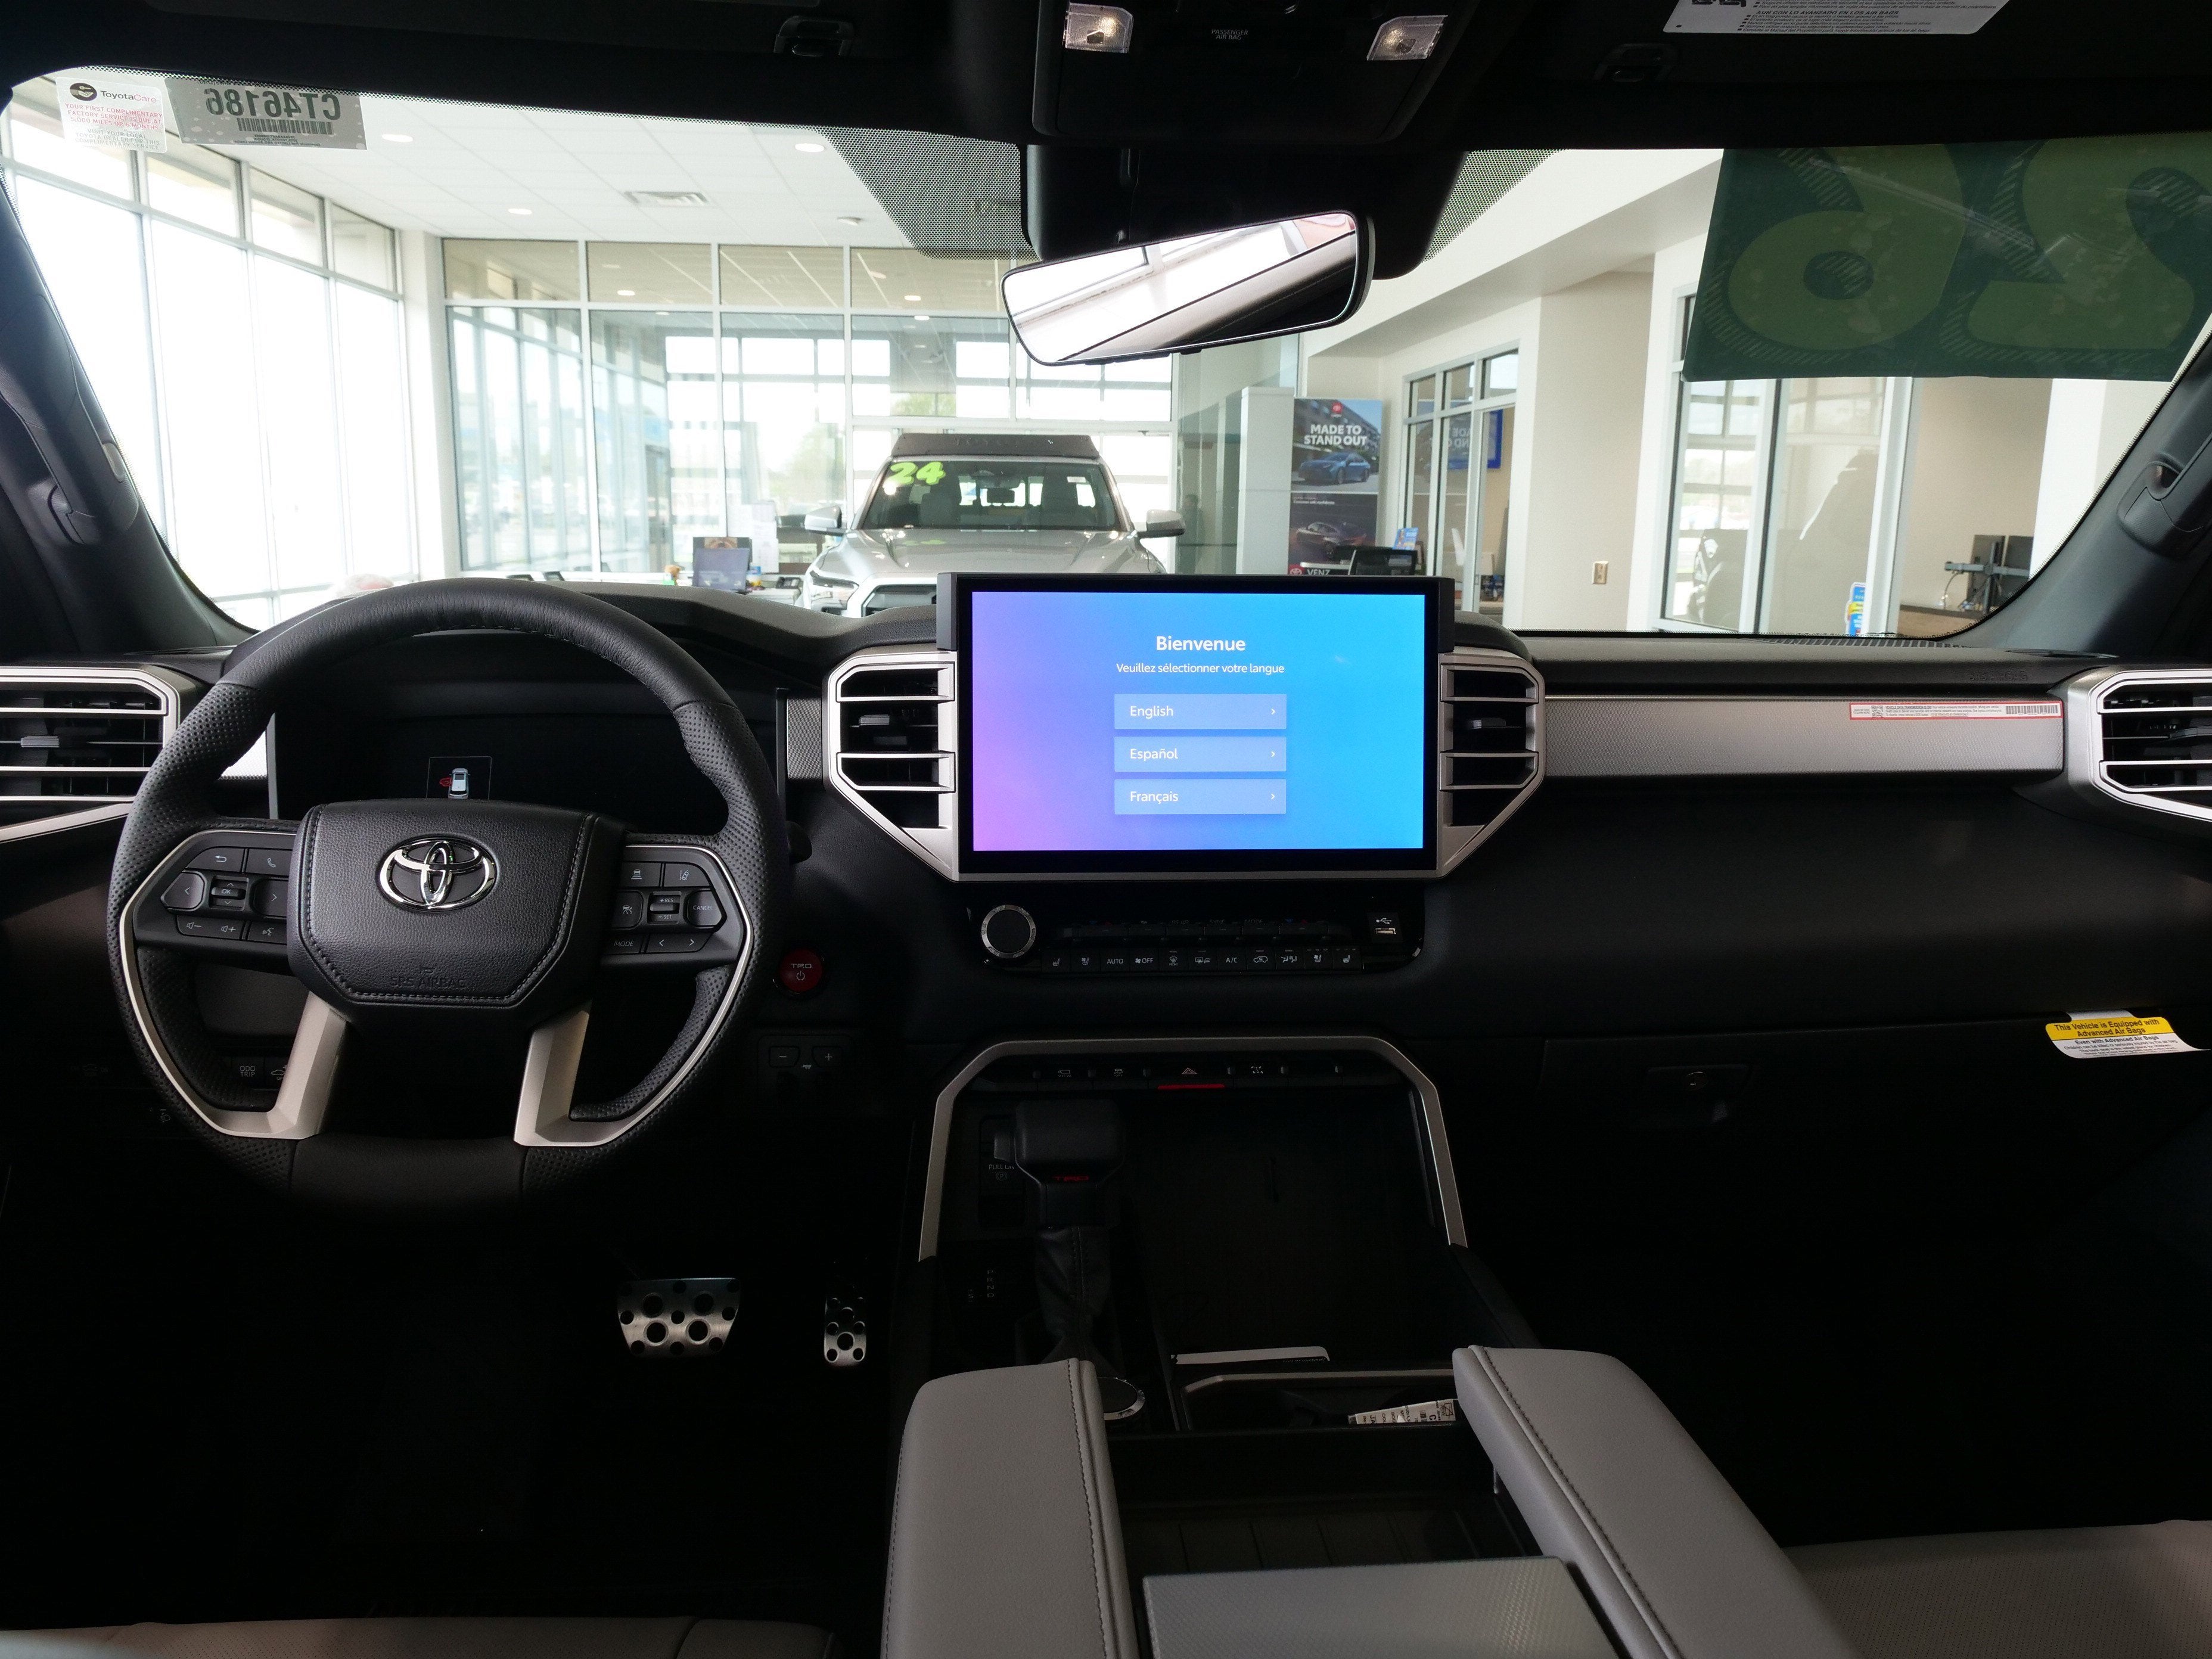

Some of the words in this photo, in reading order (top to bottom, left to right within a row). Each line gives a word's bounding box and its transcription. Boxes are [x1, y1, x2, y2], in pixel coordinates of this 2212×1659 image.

[100, 90, 157, 103] ToyotaCare
[107, 107, 163, 118] COMPLIMENTARY
[1310, 424, 1344, 434] MADE
[1346, 425, 1362, 435] TO
[1304, 434, 1342, 445] STAND
[1343, 435, 1368, 446] OUT
[890, 461, 946, 485] 24
[1156, 636, 1245, 651] Bienvenue
[1116, 663, 1156, 673] Veuillez
[1158, 663, 1220, 673] sélectionner
[1222, 664, 1248, 673] votre
[1250, 663, 1285, 675] langue
[1130, 706, 1174, 719] English
[1130, 748, 1178, 761] Español
[1130, 791, 1179, 804] Français
[2109, 1020, 2142, 1029] Equipped
[2077, 1029, 2113, 1037] Advanced
